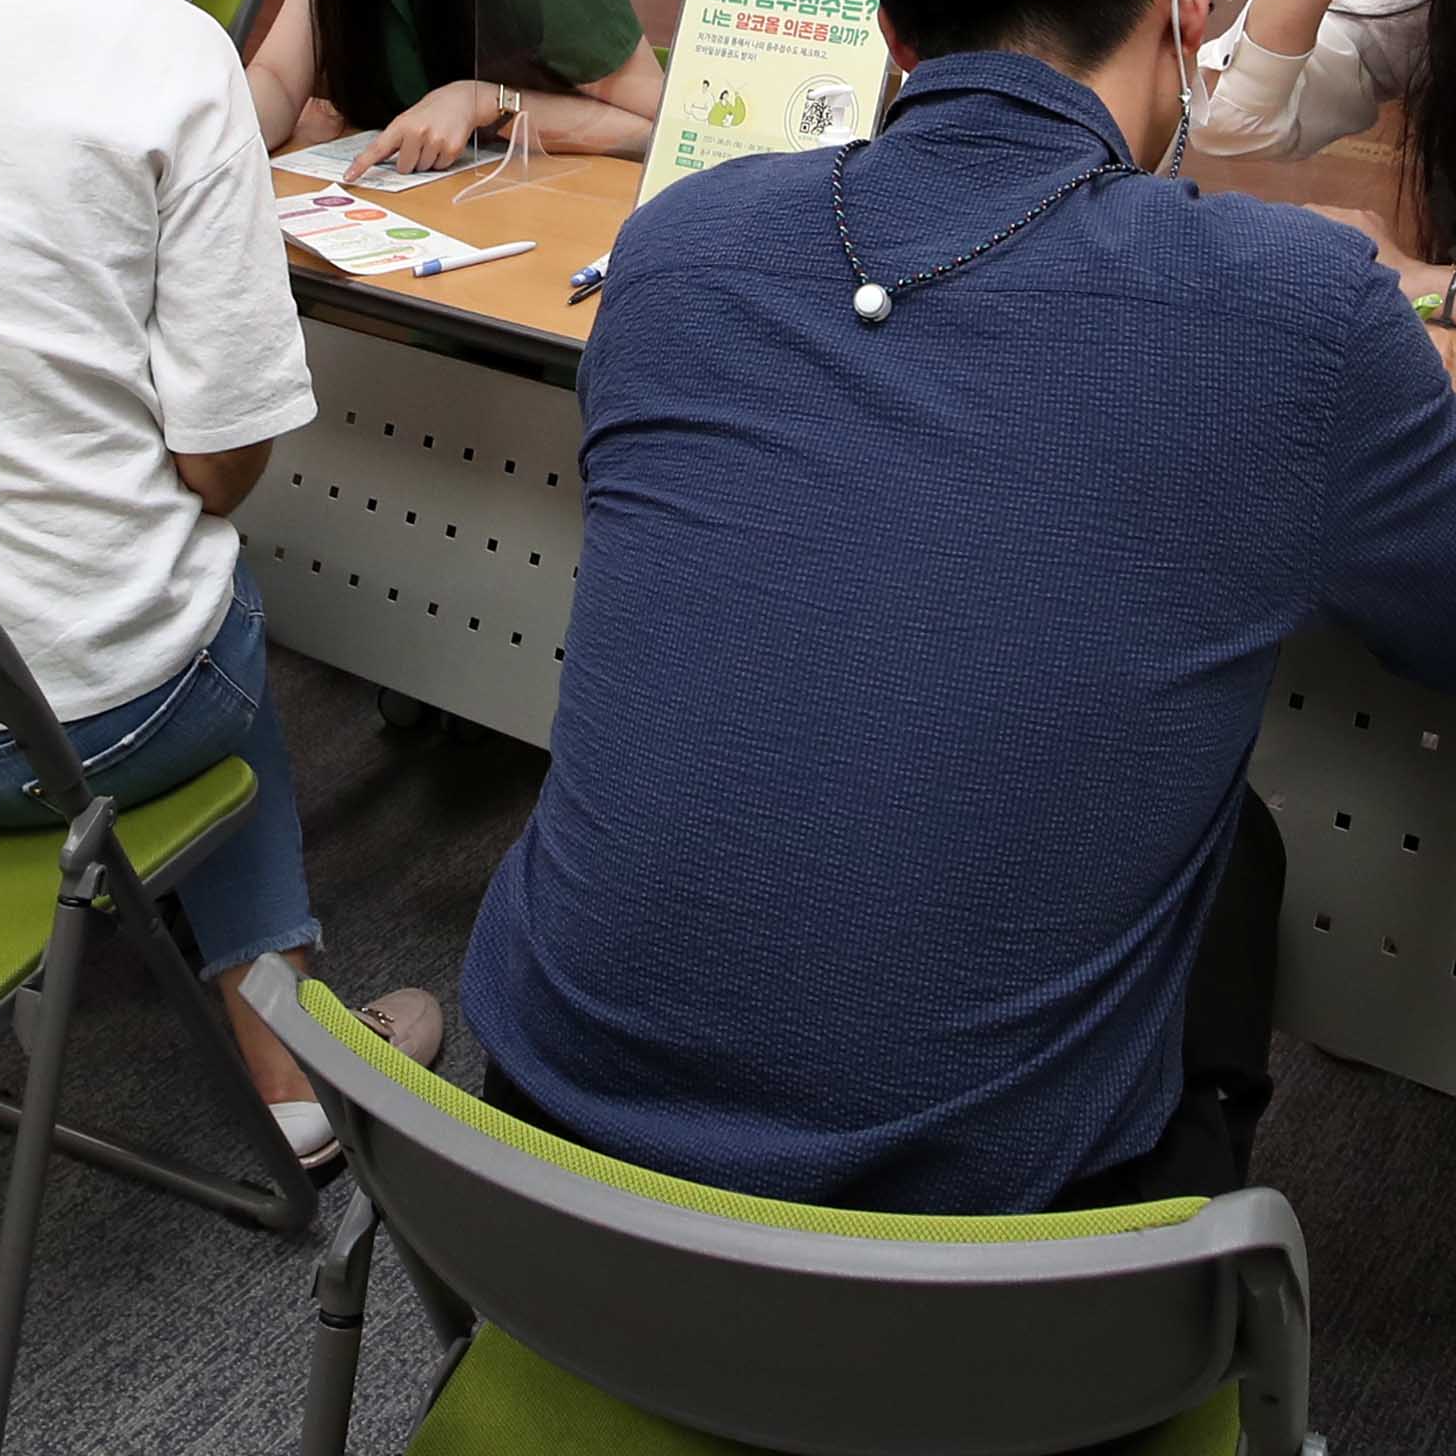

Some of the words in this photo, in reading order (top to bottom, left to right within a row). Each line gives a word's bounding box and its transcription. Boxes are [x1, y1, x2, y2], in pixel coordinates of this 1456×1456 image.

[702, 7, 732, 29] 나는
[735, 12, 780, 35] 알코올
[782, 18, 870, 47] 의존증일까?
